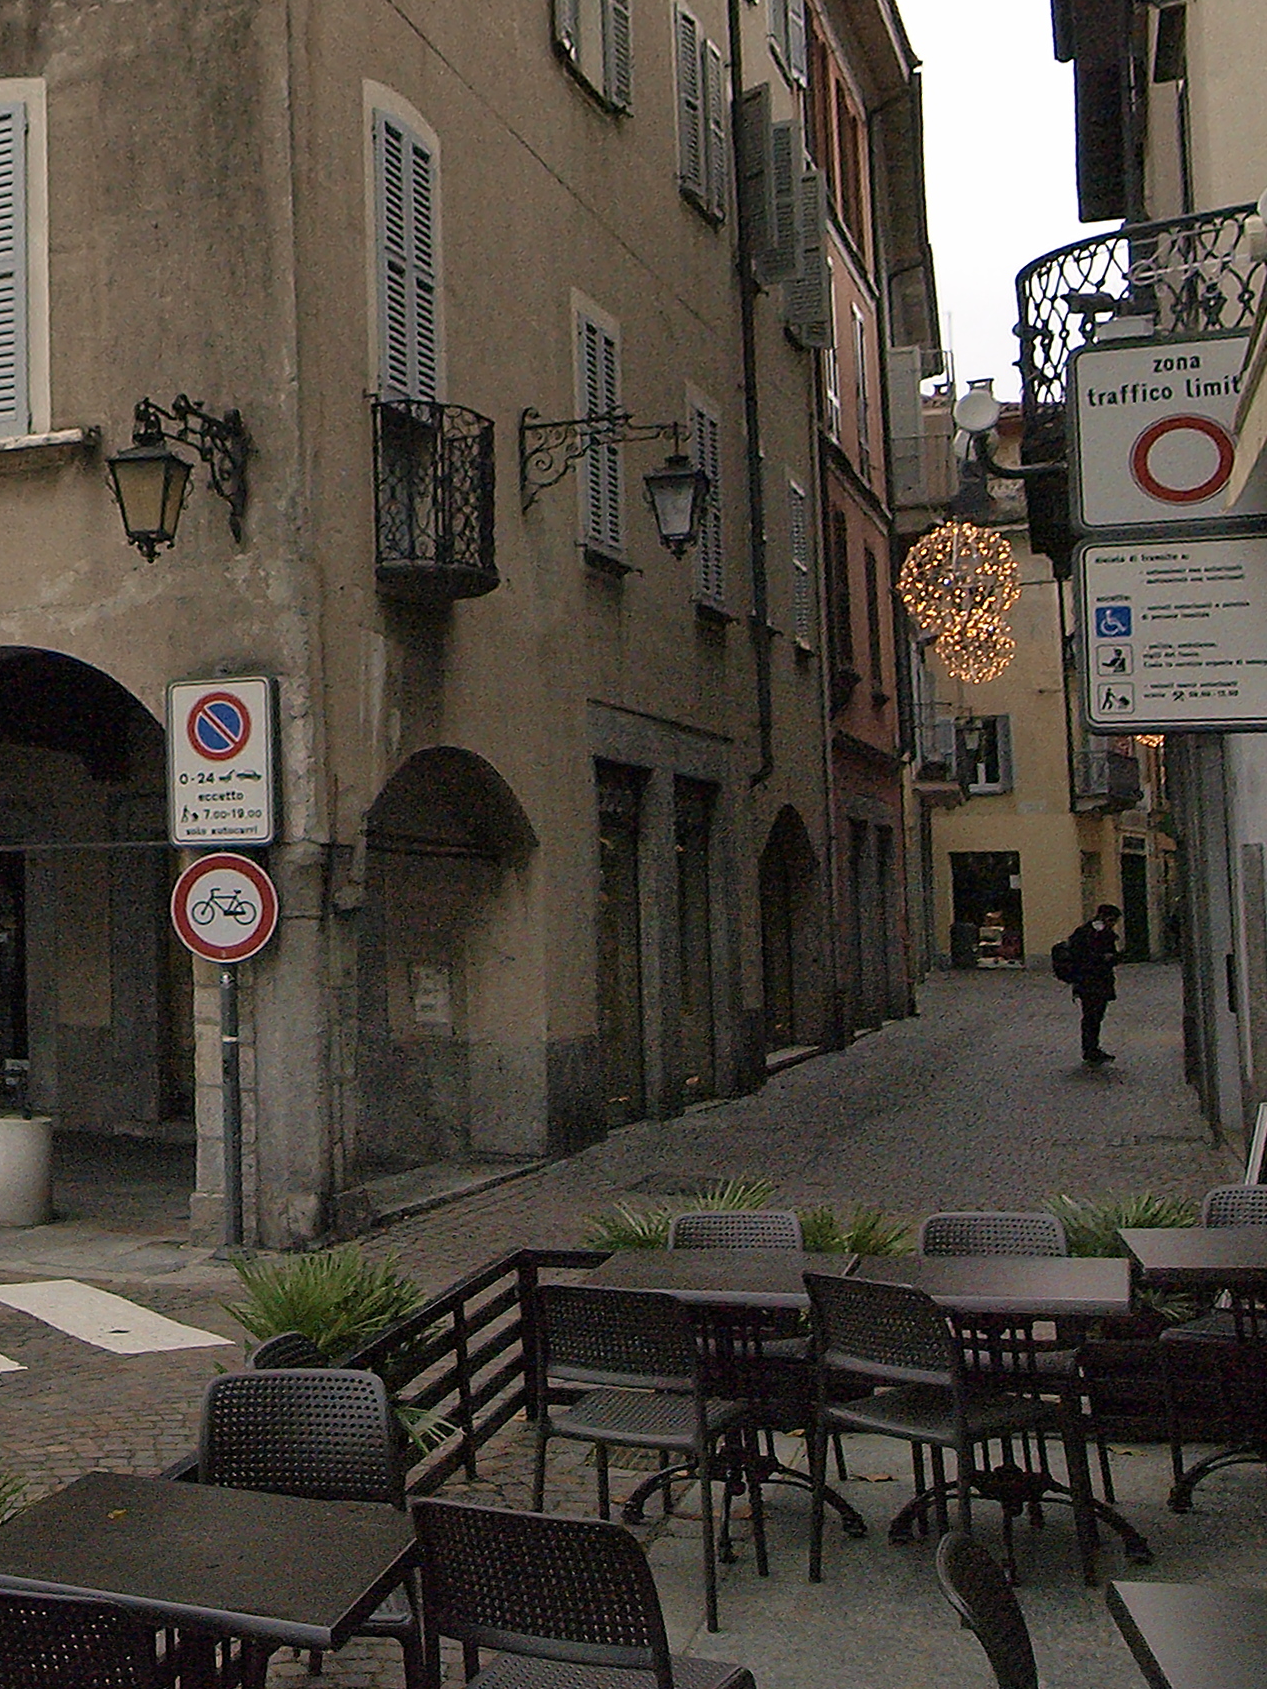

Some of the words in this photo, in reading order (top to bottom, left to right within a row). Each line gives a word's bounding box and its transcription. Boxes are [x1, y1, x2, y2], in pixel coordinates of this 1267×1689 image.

[1153, 355, 1201, 373] zona
[1086, 383, 1174, 407] traffico
[198, 791, 244, 801] eccetto
